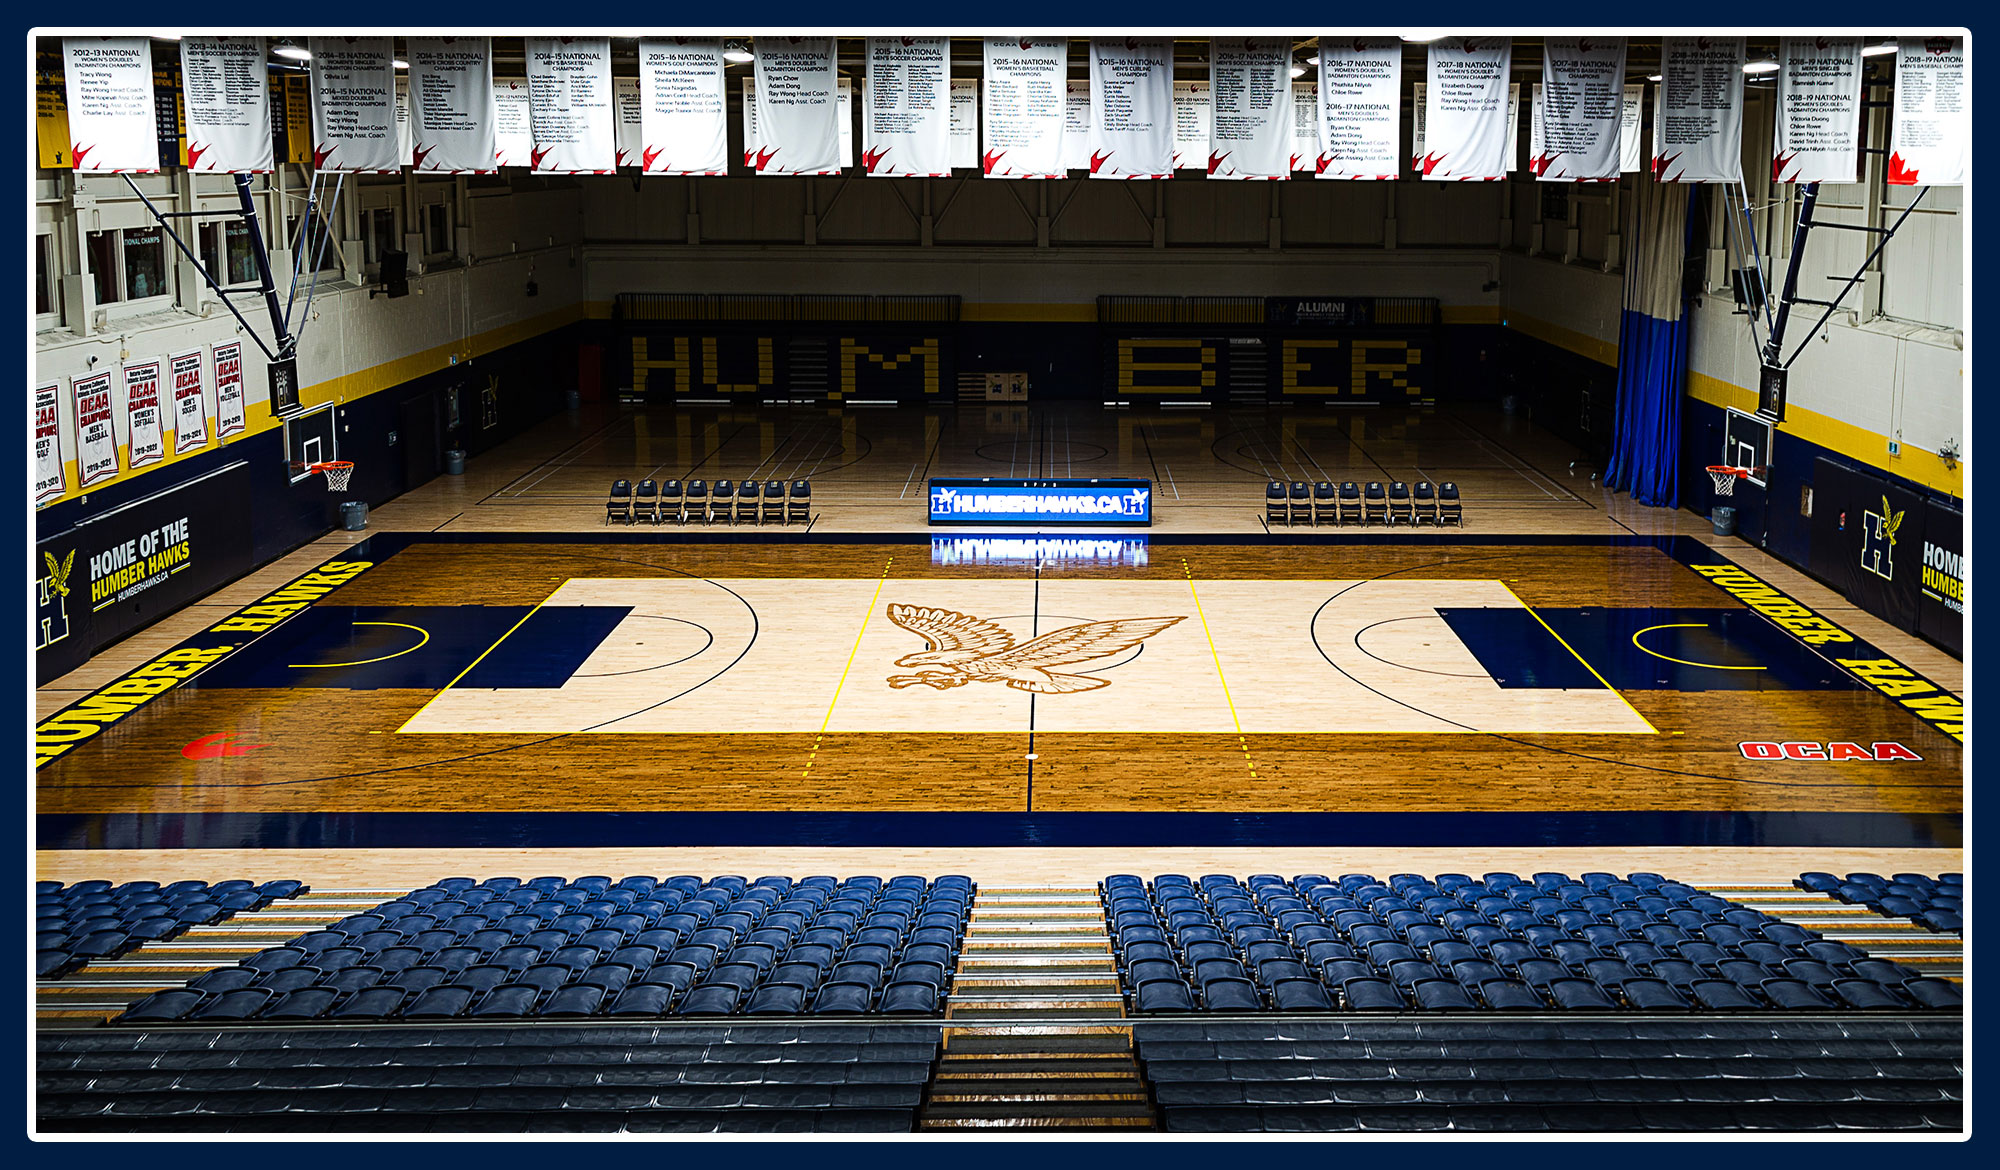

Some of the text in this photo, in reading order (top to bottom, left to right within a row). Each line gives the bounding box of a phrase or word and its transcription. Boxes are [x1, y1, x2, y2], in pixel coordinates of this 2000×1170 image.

[1297, 302, 1345, 312] ALUMNI
[130, 380, 157, 400] OCAA
[176, 370, 199, 390] OCAA
[80, 392, 108, 415] OCAA
[128, 396, 158, 413] CHAMPIONS
[80, 408, 110, 428] CHAMPIONS
[85, 430, 108, 444] BASEBALL
[89, 423, 104, 434] MEN'S
[36, 448, 49, 458] GOLF
[953, 495, 1123, 514] HUMBERHAWKS.CA
[90, 516, 189, 581] HOME OF THE
[91, 540, 190, 603] HUMBER HAWKS
[117, 570, 169, 602] HUMBERHAWKS.CA
[209, 561, 373, 632] HAWKS
[1689, 564, 1854, 644] HUMBER
[1739, 741, 1924, 761] OCAA
